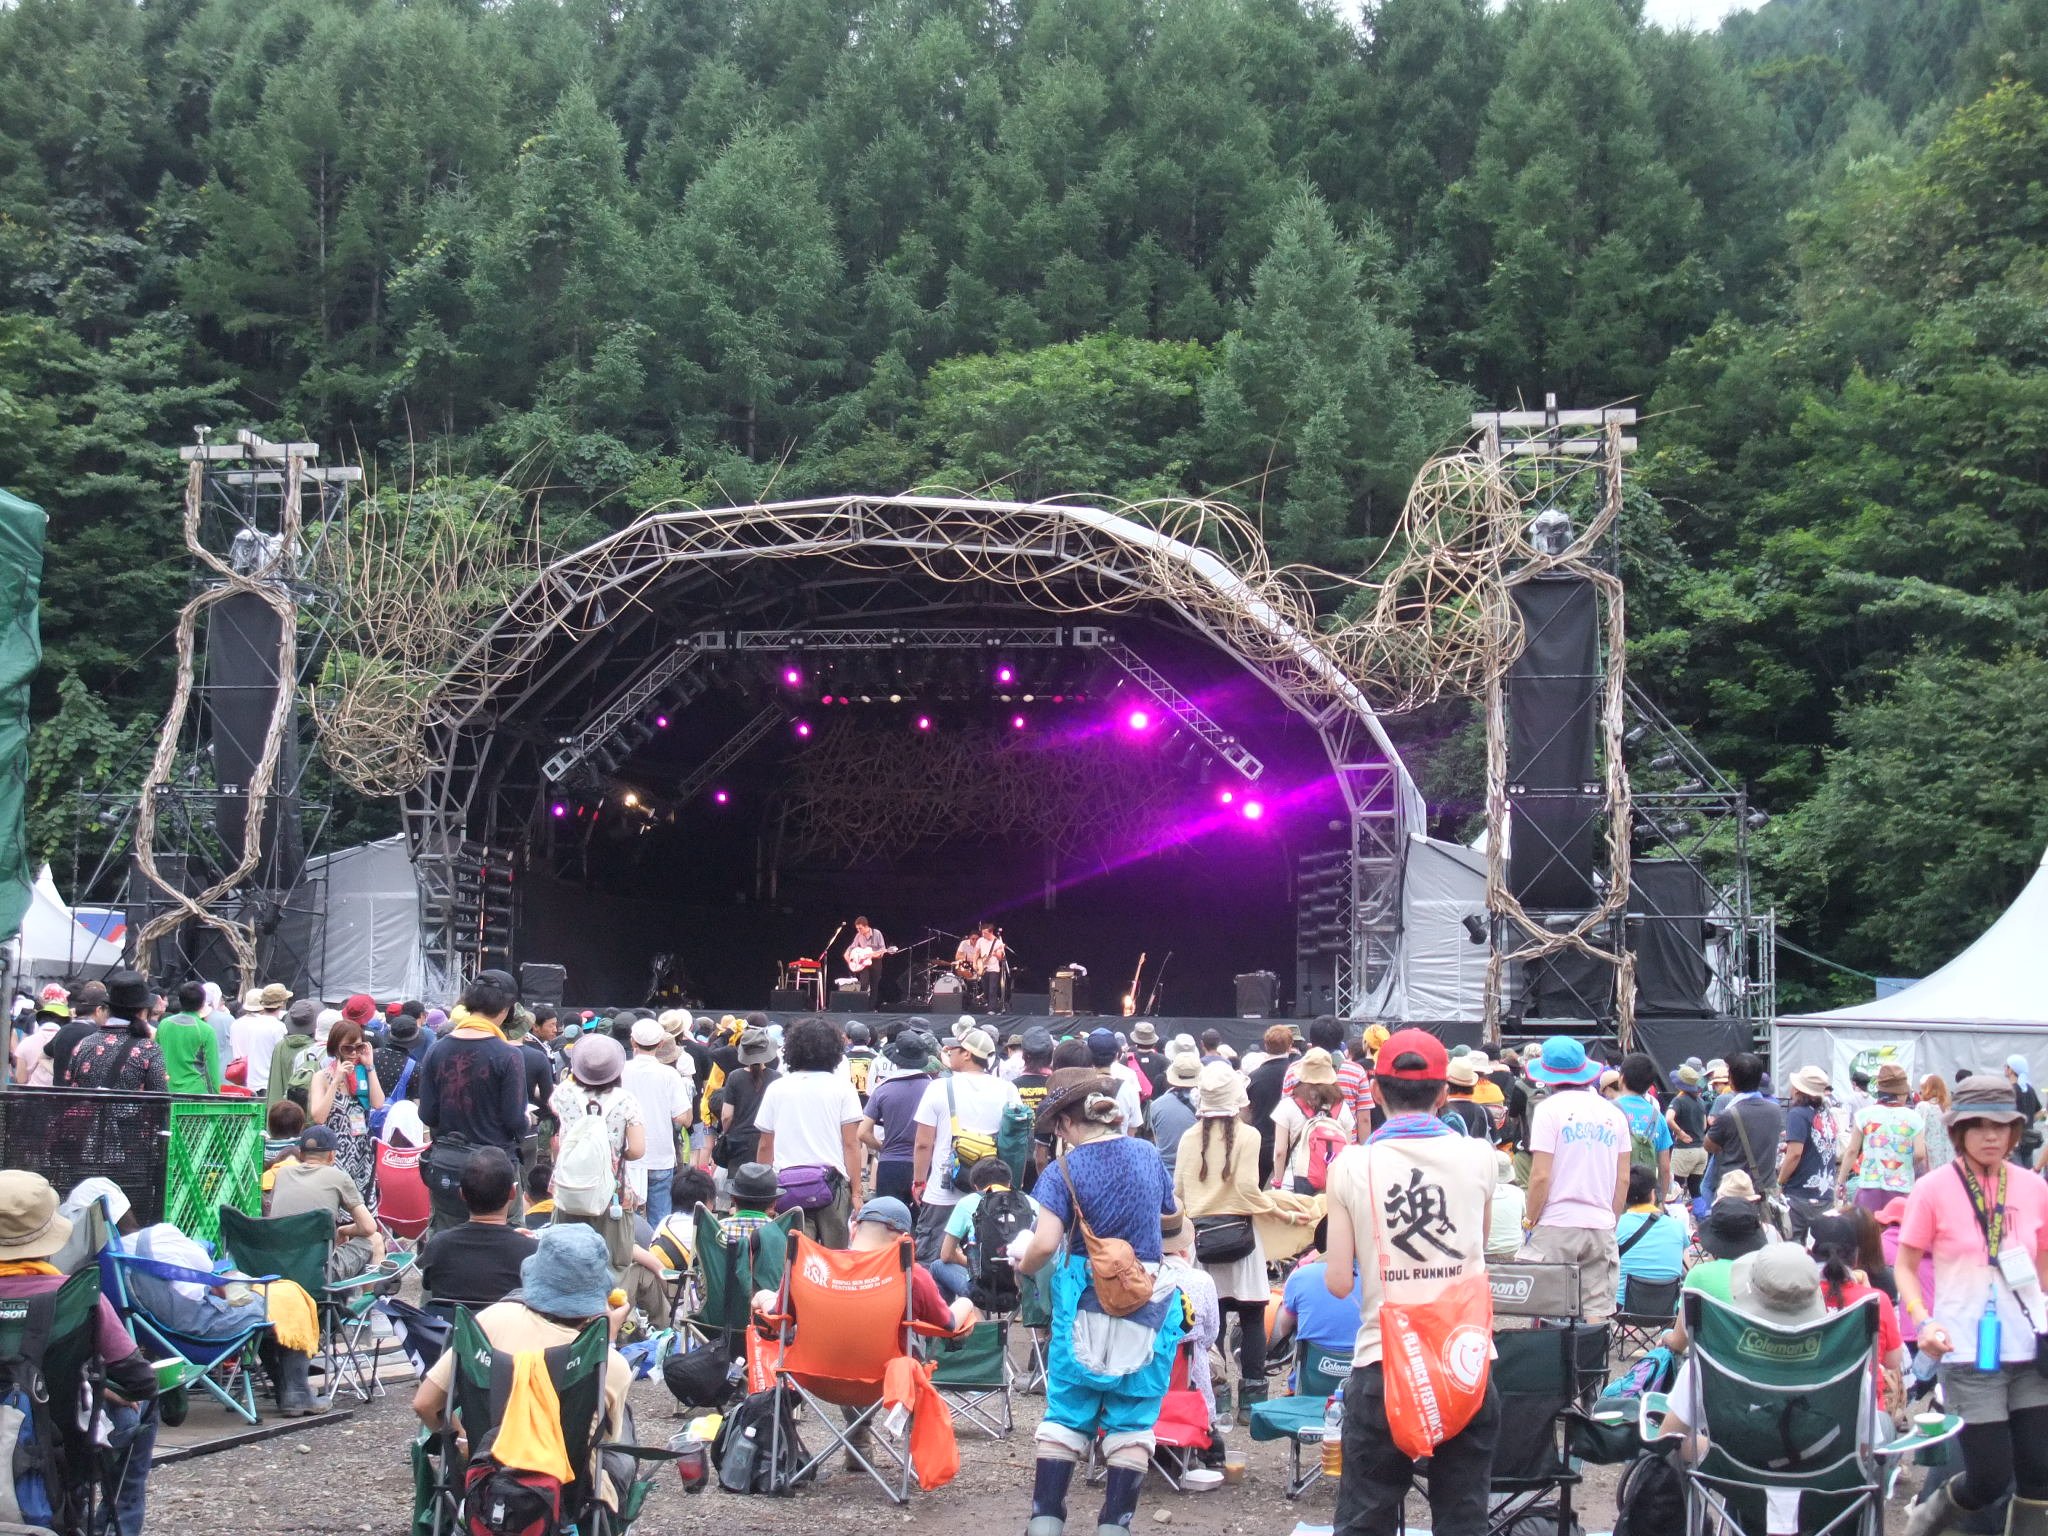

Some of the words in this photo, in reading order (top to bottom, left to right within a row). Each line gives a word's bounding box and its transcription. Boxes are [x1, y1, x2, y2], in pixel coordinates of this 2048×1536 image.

[1384, 1168, 1466, 1262] 魂
[1413, 1265, 1462, 1280] RUNNING
[1747, 1332, 1804, 1355] Coleman
